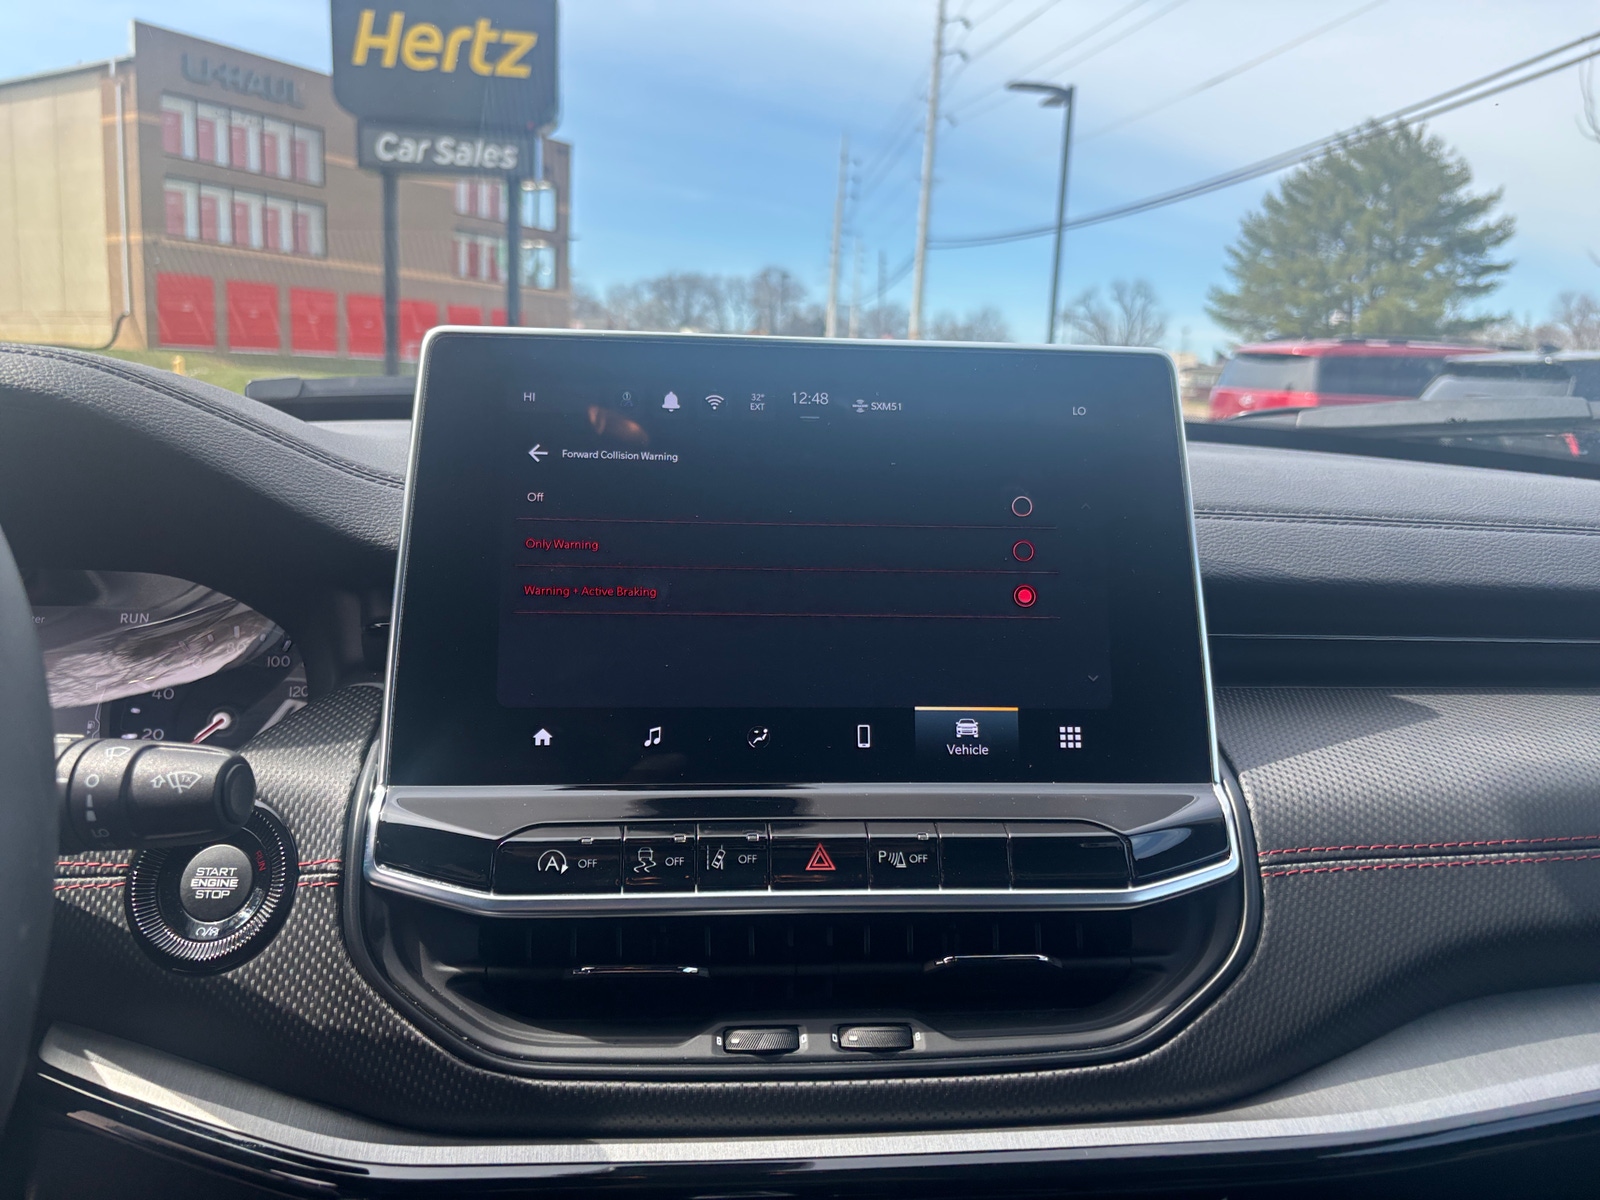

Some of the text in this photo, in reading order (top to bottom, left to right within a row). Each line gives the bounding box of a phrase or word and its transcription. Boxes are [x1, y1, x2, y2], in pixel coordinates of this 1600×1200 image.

[351, 8, 538, 79] Hertz
[374, 131, 518, 169] Car Sales
[523, 392, 536, 402] HI
[792, 391, 829, 405] 12:48
[750, 402, 765, 411] EXT
[871, 401, 902, 411] SXM51
[1072, 406, 1087, 416] LO
[561, 449, 679, 463] Forward Collision Warning
[526, 491, 545, 502] Off
[525, 538, 599, 551] Only Warning
[524, 585, 570, 598] Warning
[581, 587, 614, 597] Active
[616, 586, 657, 599] Braking
[120, 612, 150, 624] RUN
[267, 655, 291, 668] 100
[152, 687, 175, 700] 40
[141, 728, 165, 741] 20
[946, 744, 989, 756] Vehicle
[577, 858, 598, 869] OFF
[665, 856, 685, 867] OFF
[738, 854, 758, 865] OFF
[909, 854, 928, 863] OFF
[195, 867, 238, 877] START
[190, 878, 239, 888] ENGINE
[194, 889, 231, 899] STOP
